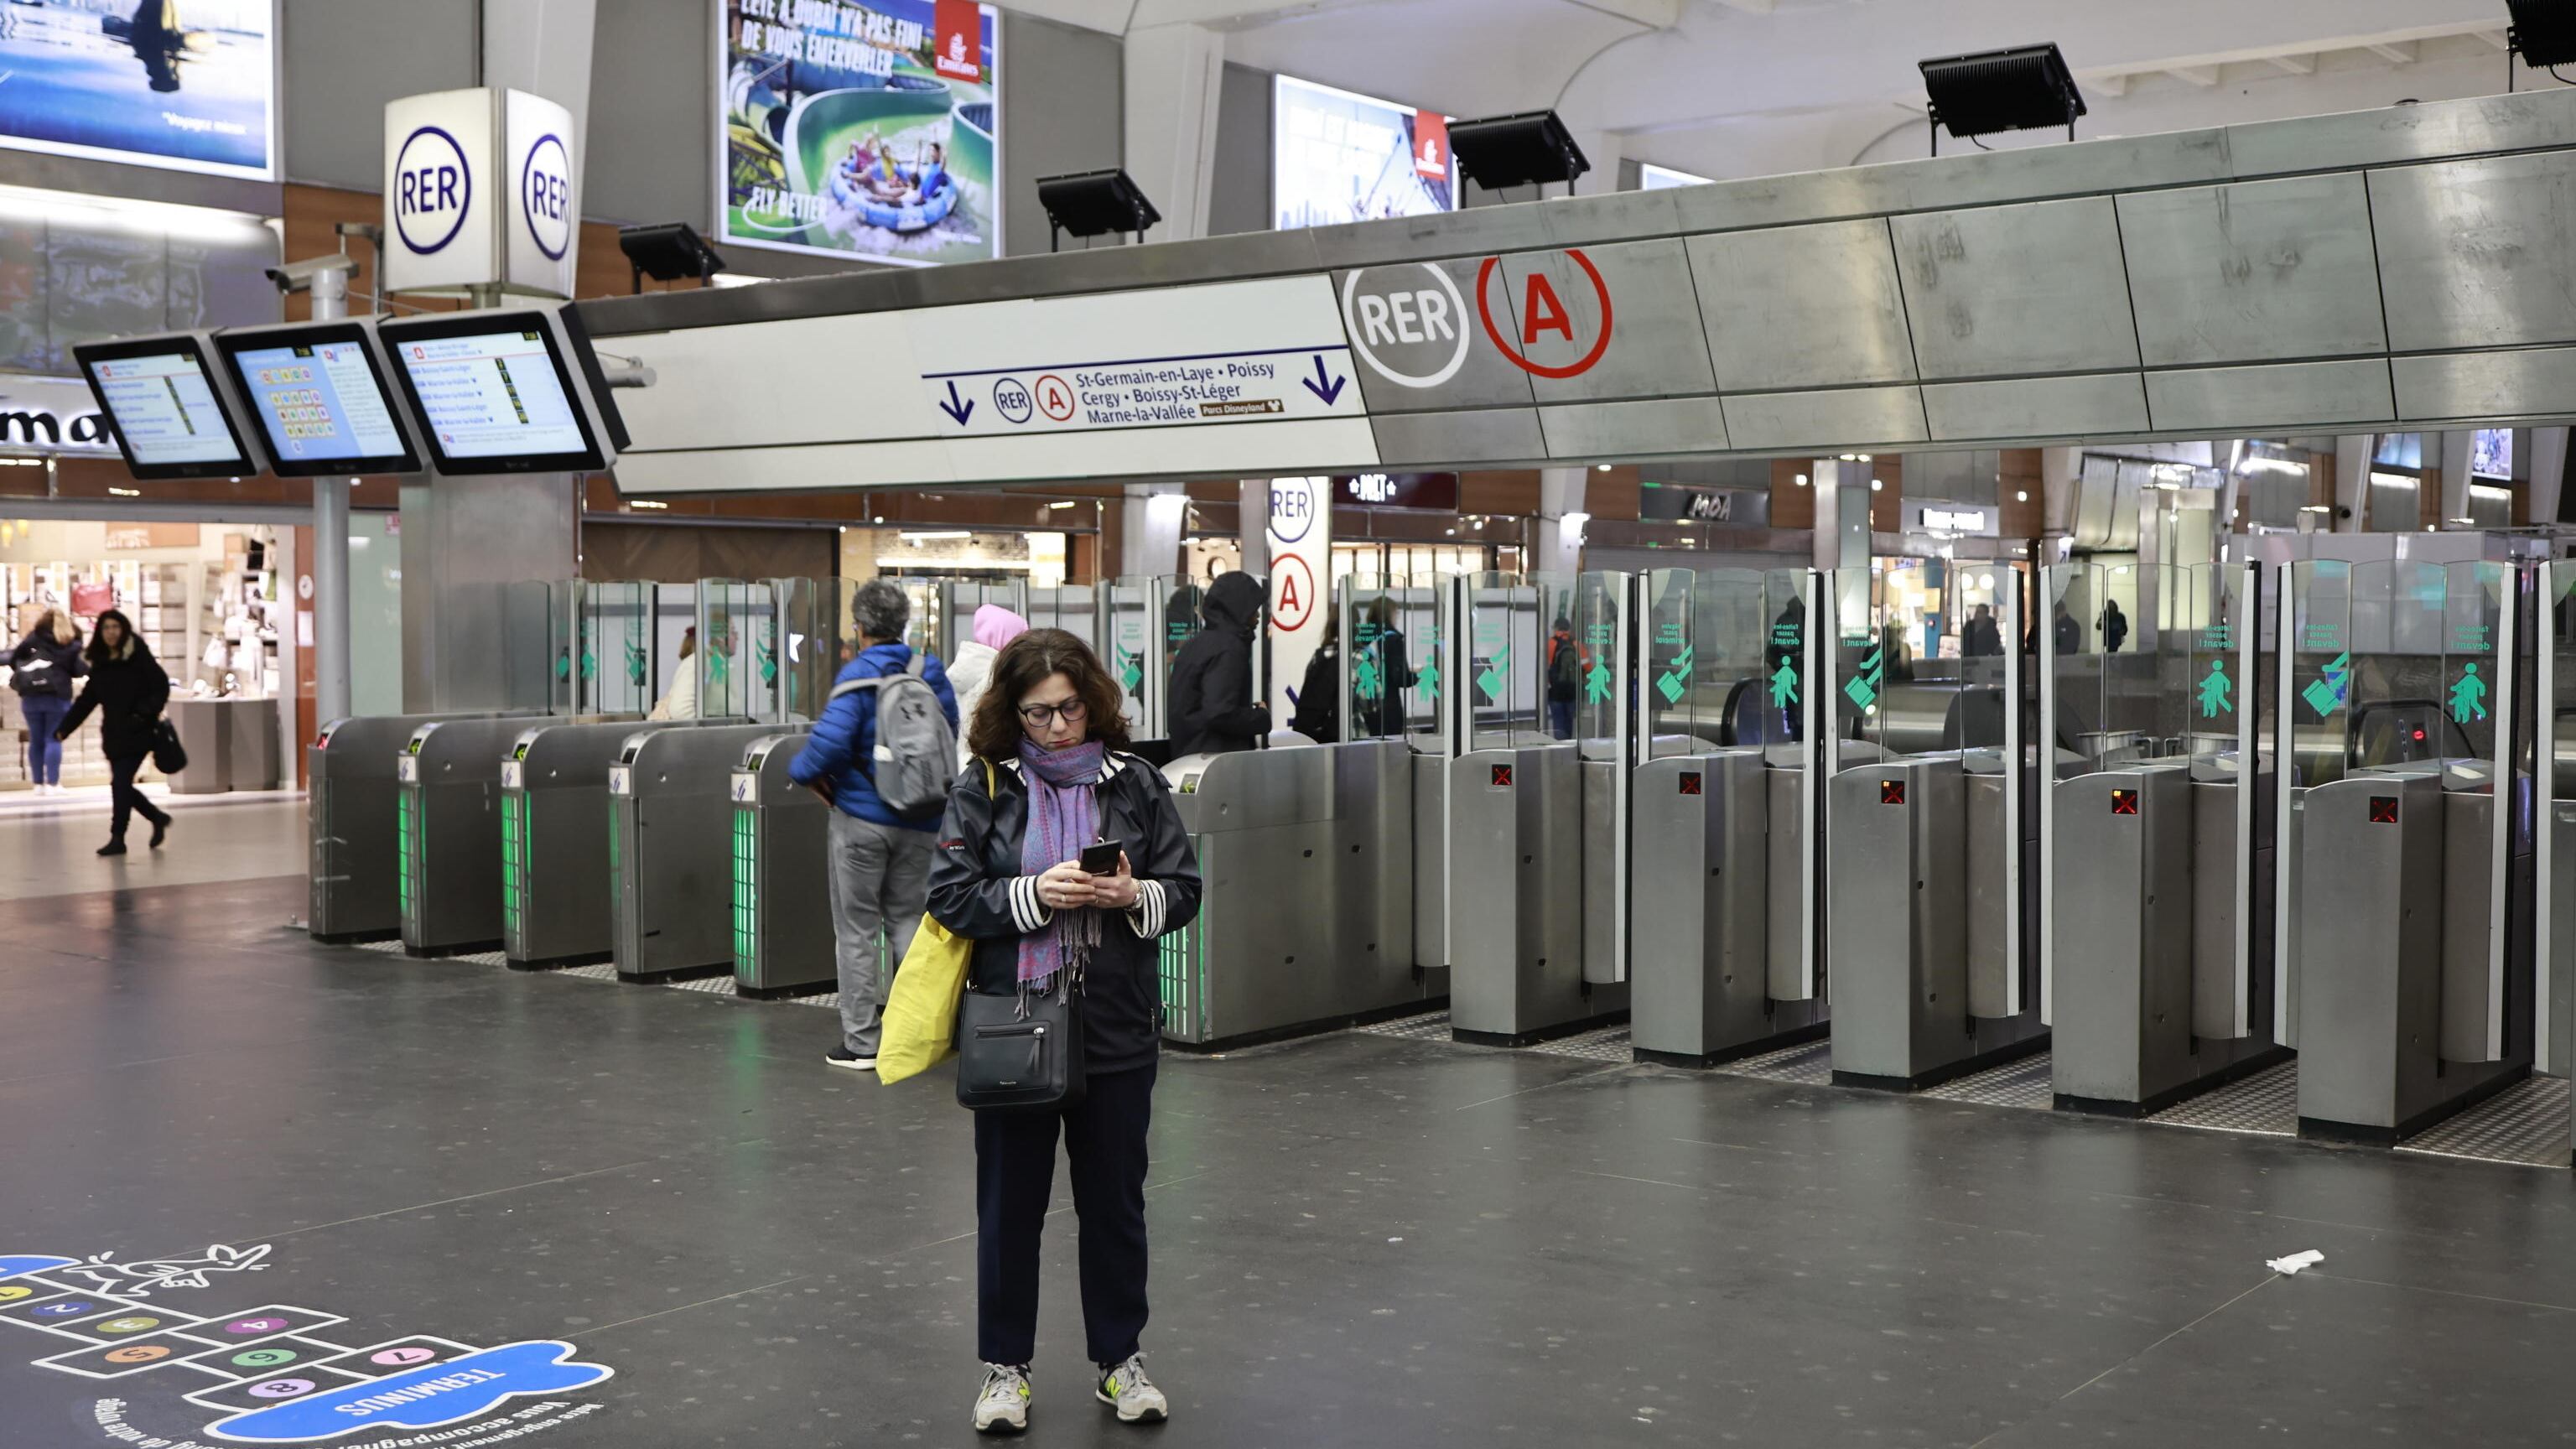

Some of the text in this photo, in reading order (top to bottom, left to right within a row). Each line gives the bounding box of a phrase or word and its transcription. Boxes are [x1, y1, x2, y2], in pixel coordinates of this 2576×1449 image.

[741, 19, 762, 51] DE
[766, 24, 804, 60] VOUS
[866, 12, 893, 44] PAS
[895, 18, 922, 50] FINI
[402, 165, 458, 216] RER
[532, 169, 569, 224] RER
[1358, 289, 1456, 346] RER
[1523, 273, 1574, 345] A
[1076, 361, 1275, 387] St-Germain-en-Laye Poissy
[998, 391, 1029, 410] RER
[1048, 387, 1067, 410] A
[1081, 383, 1241, 408] Cergy Boissy-St-Léger
[1087, 404, 1197, 423] Marne-la-Vallée
[1202, 402, 1266, 415] Parcs Disneyland
[1271, 490, 1308, 517] RER
[1688, 493, 1732, 521] MOA
[1279, 574, 1301, 611] A
[44, 1303, 80, 1313] 2
[112, 1319, 144, 1329] 3
[241, 1320, 269, 1330] 4
[122, 1348, 153, 1359] 5
[392, 1351, 423, 1362] 7
[263, 1382, 299, 1394] 8
[334, 1368, 507, 1416] TERMINUS
[94, 1398, 127, 1425] voyage
[512, 1401, 571, 1419] Vous
[103, 1422, 148, 1441] votre
